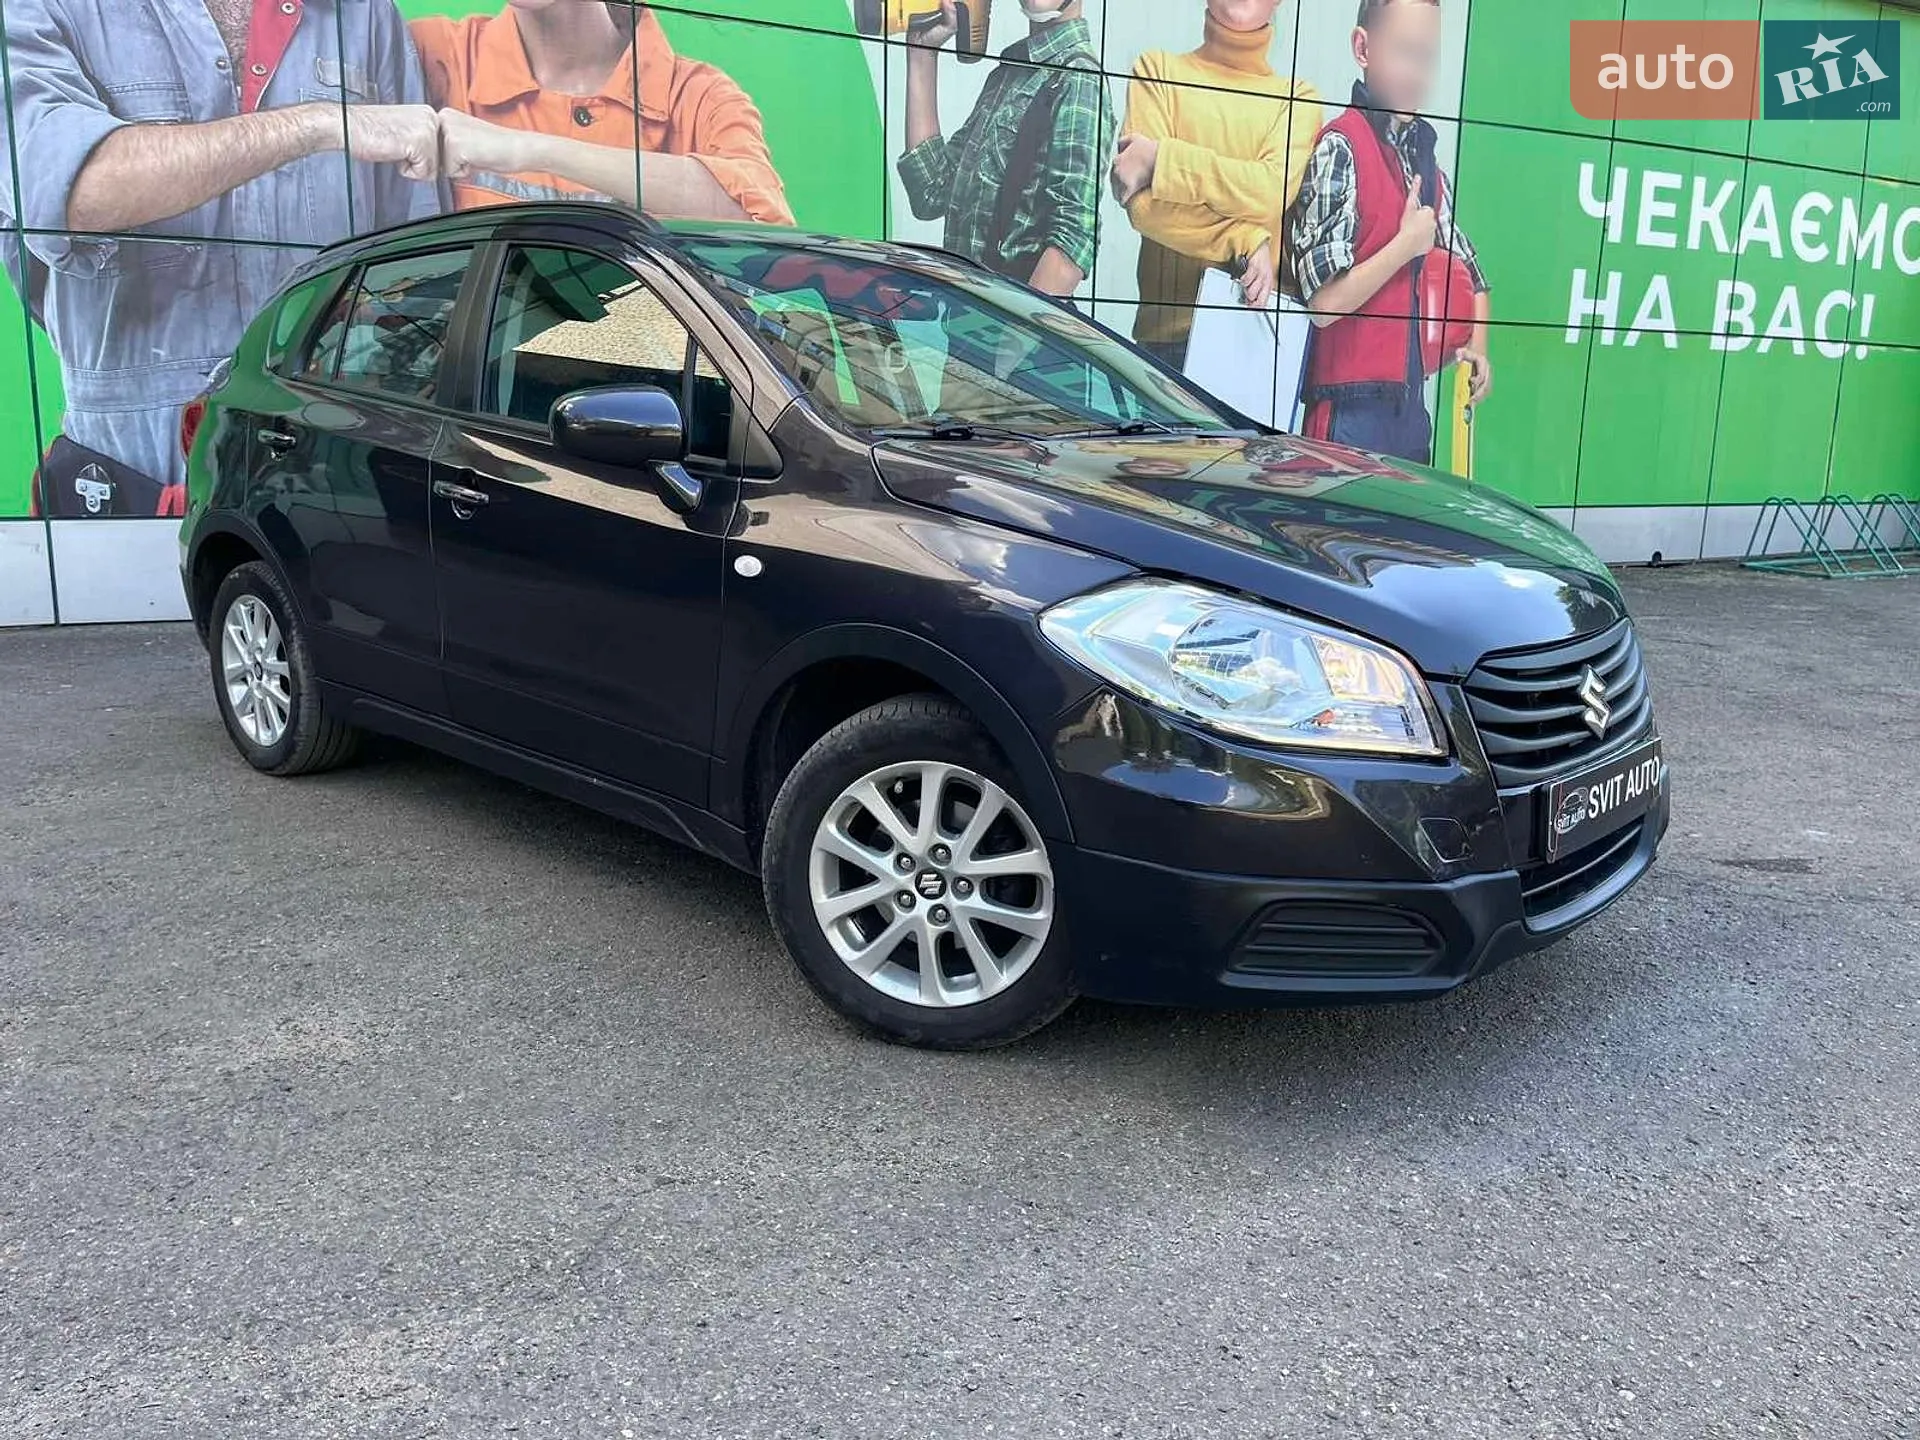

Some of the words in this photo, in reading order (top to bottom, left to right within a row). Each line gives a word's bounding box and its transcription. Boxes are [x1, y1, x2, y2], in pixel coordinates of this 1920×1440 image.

[1565, 268, 1678, 349] НА
[1709, 279, 1875, 360] ВАС!
[1588, 774, 1624, 819] SVIT
[1625, 756, 1660, 802] AUTO
